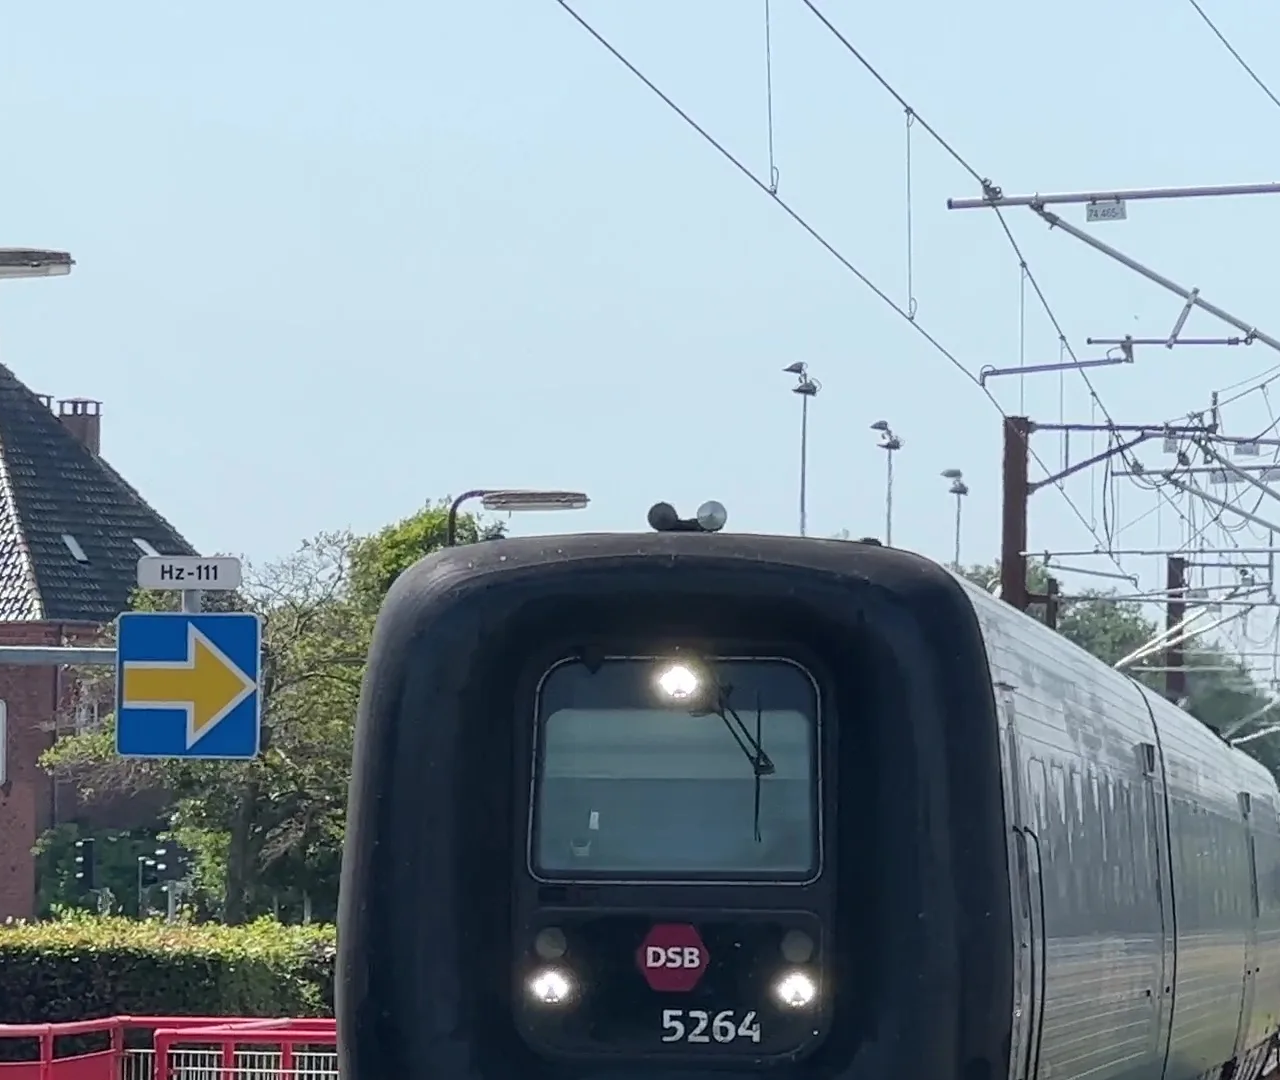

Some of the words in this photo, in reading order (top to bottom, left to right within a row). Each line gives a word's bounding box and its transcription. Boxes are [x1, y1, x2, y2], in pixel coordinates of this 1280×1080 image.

[161, 564, 218, 580] Hz-111
[646, 946, 700, 968] DSB
[662, 1009, 761, 1043] 5264
